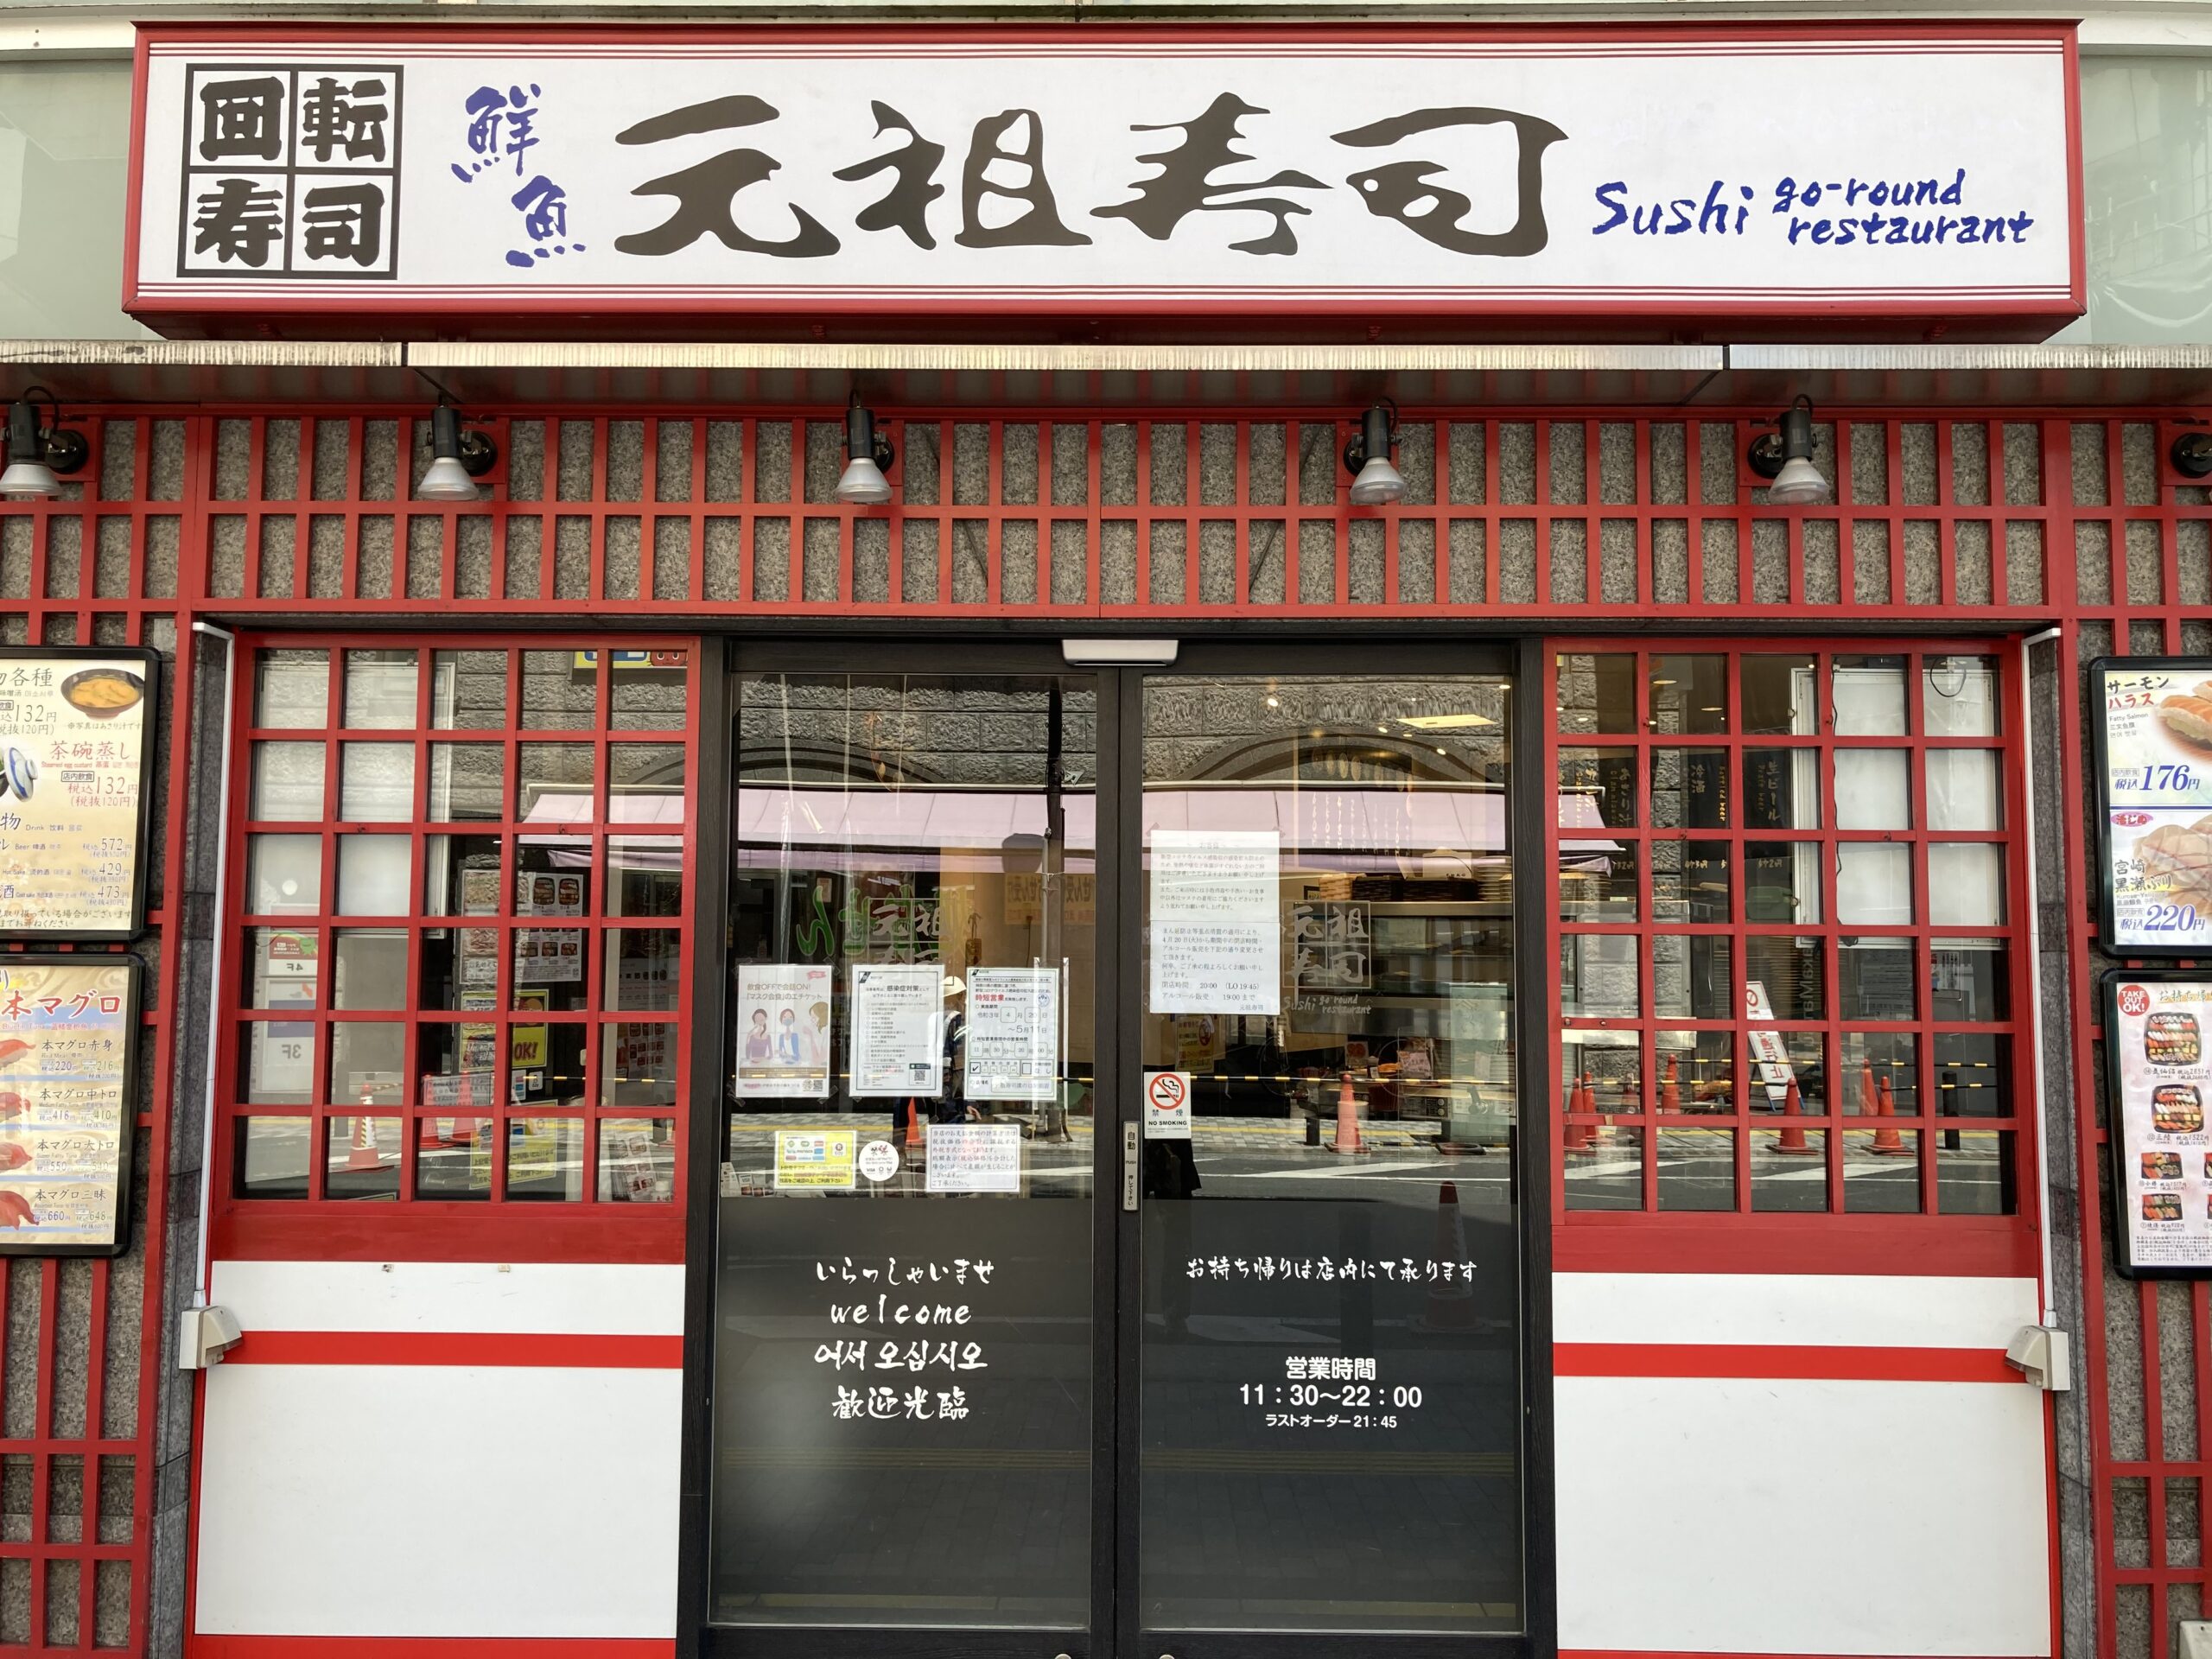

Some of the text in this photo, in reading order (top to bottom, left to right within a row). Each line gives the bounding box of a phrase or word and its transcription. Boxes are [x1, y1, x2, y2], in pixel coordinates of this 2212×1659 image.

[200, 76, 388, 162] 回転
[614, 92, 1569, 257] 元祖寿司
[1592, 168, 1966, 236] Sushi go-round
[193, 179, 385, 267] 寿司
[1788, 210, 2035, 246] restaurant
[2107, 677, 2169, 694] サーモン
[2109, 692, 2154, 709] ハラス
[50, 741, 130, 760] 茶碗蒸し
[69, 776, 138, 794] 税込132円
[2115, 765, 2201, 791] 税込176円
[2114, 859, 2145, 875] 宮崎
[2120, 905, 2205, 931] 税込220円
[2, 990, 121, 1020] 本マグロ
[1283, 995, 1317, 1011] Sushi
[2122, 1003, 2145, 1013] OK!
[2159, 989, 2212, 1003] お持ち帰
[41, 1039, 112, 1052] 本マグロ赤身
[40, 1088, 117, 1101] 本マグロ中トロ
[37, 1139, 114, 1151] 本マグロ大トロ
[1127, 1131, 1136, 1151] 自動
[817, 1256, 995, 1286] いらっしゃいませ
[1186, 1255, 1478, 1283] お持ち帰りは店内にて承ります
[830, 1294, 972, 1325] welcome
[814, 1340, 988, 1372] 어서 오십시오
[1285, 1357, 1376, 1381] 営業時間
